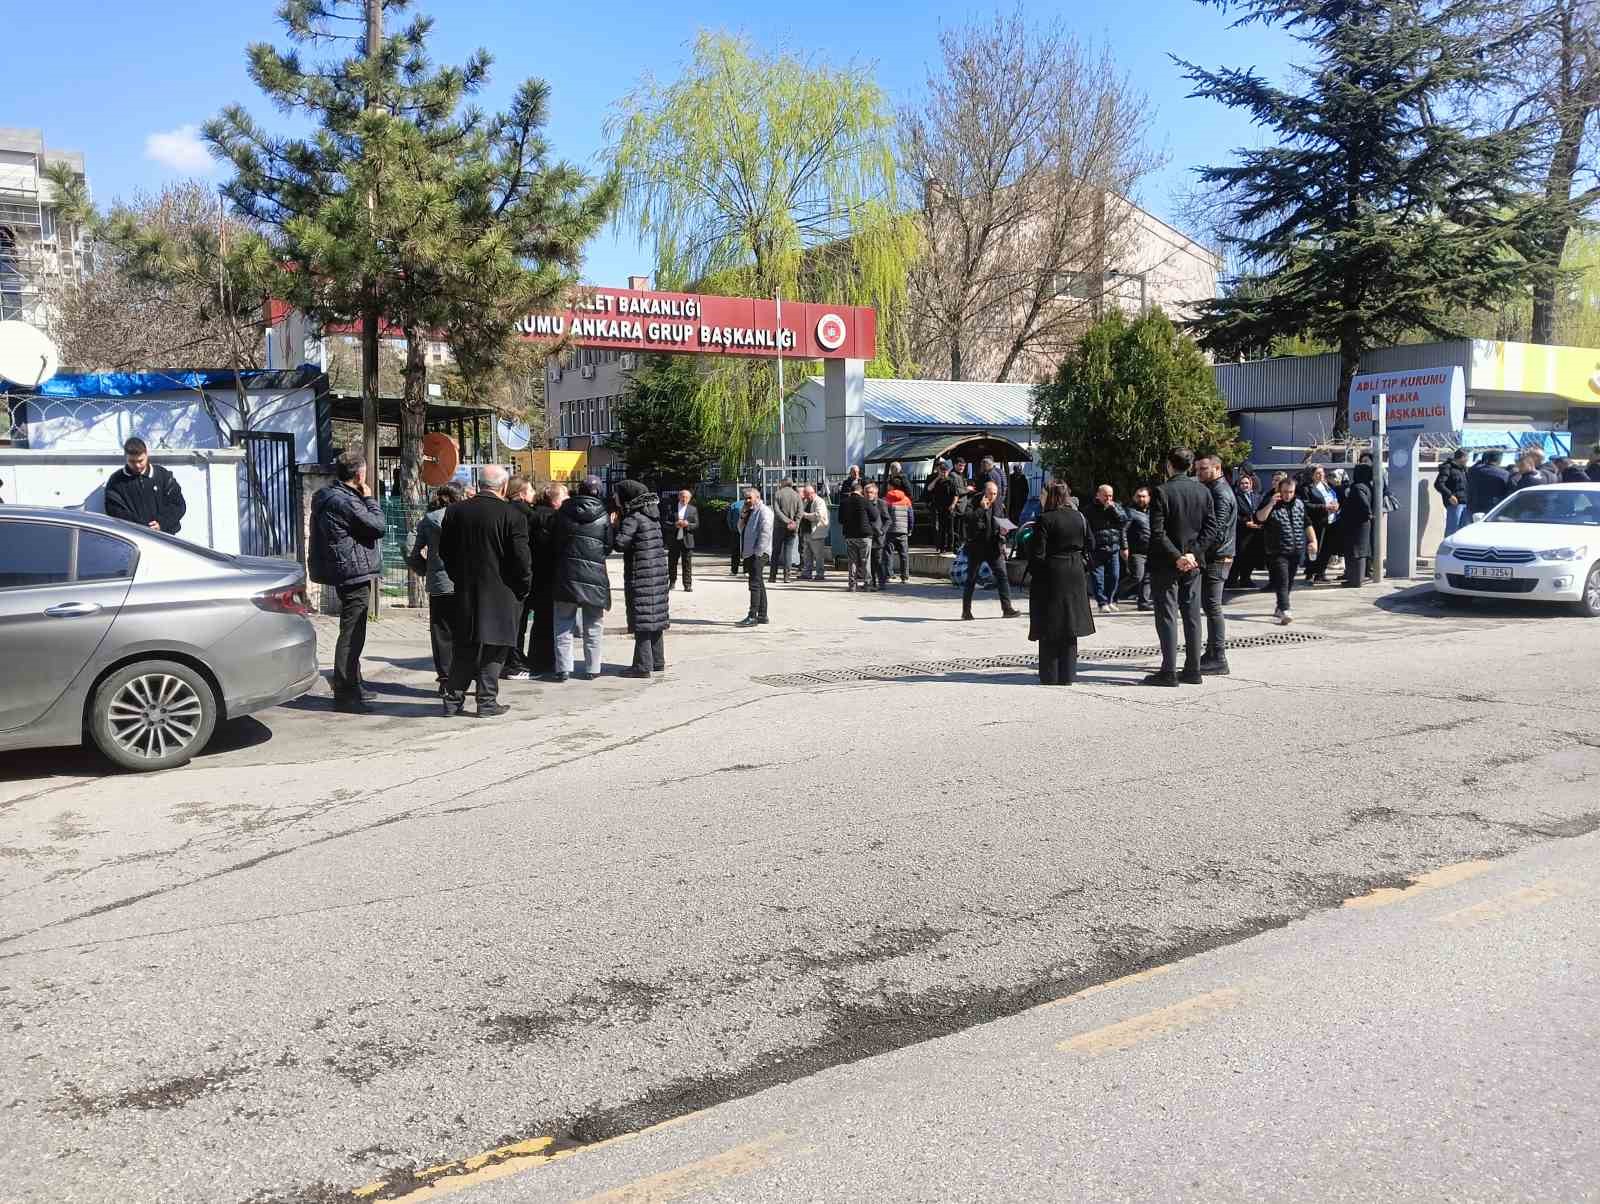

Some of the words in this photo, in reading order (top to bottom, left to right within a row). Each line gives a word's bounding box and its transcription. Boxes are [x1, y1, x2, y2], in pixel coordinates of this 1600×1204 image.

[619, 296, 701, 317] BAKANLIĞI
[571, 318, 643, 340] ANKARA
[648, 322, 694, 342] GRUP
[700, 325, 797, 348] BAŞKANLIĞI
[1401, 373, 1447, 388] KURUMU
[1385, 391, 1420, 403] NKARA
